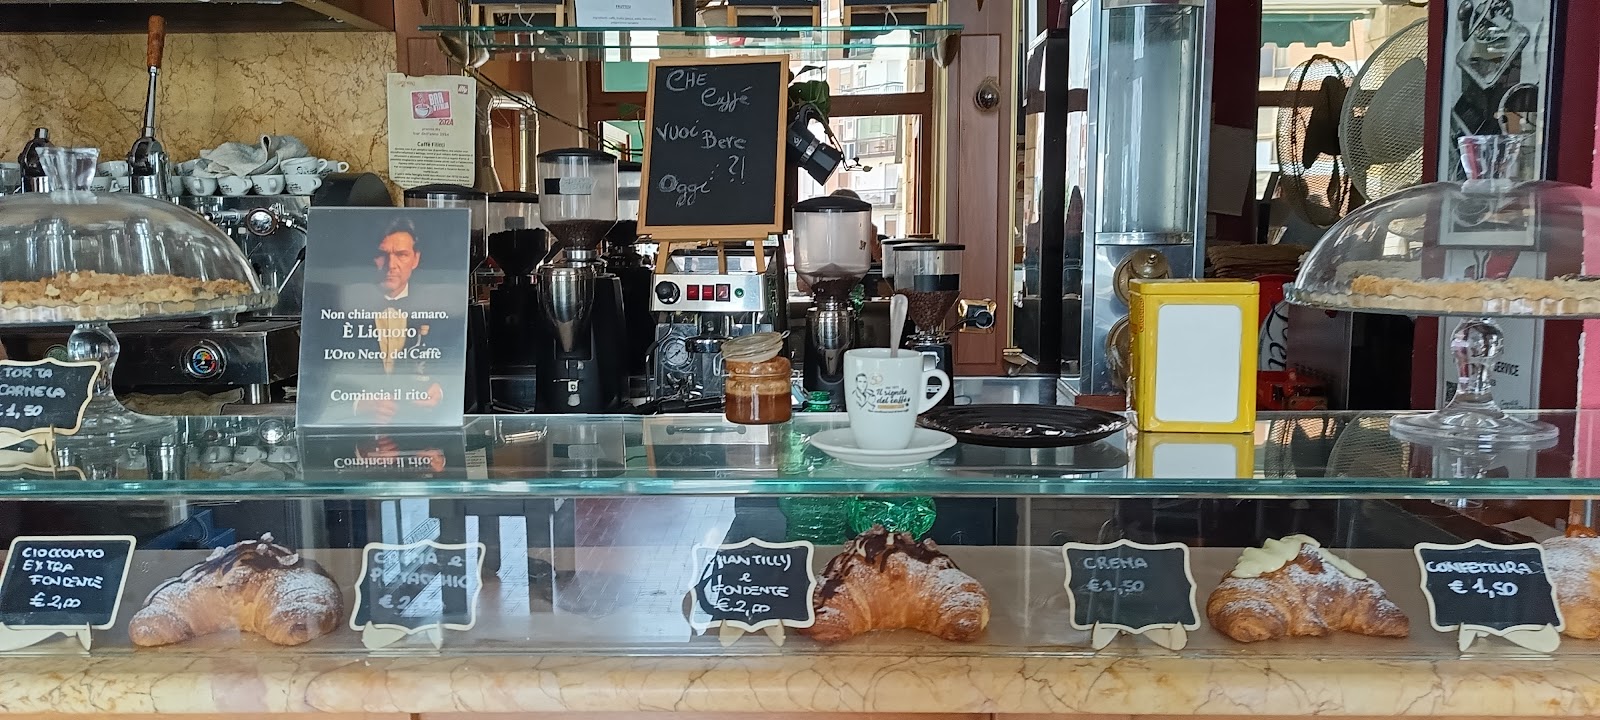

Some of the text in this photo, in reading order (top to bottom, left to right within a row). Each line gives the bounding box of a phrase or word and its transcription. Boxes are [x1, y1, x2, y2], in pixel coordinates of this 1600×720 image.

[666, 69, 708, 91] CHE
[320, 309, 449, 320] Non chiamatelo amaro.
[342, 322, 417, 342] È Liquoro
[358, 349, 387, 360] Nero
[390, 348, 407, 359] del
[330, 389, 431, 401] Comincia il rito.
[22, 547, 105, 559] CIOCCOLATO
[22, 560, 75, 573] EXTRA
[1083, 556, 1148, 569] CREMA
[1425, 561, 1532, 575] CONFETTURA
[28, 574, 104, 589] FONDENTE
[712, 574, 789, 597] FONDENTE
